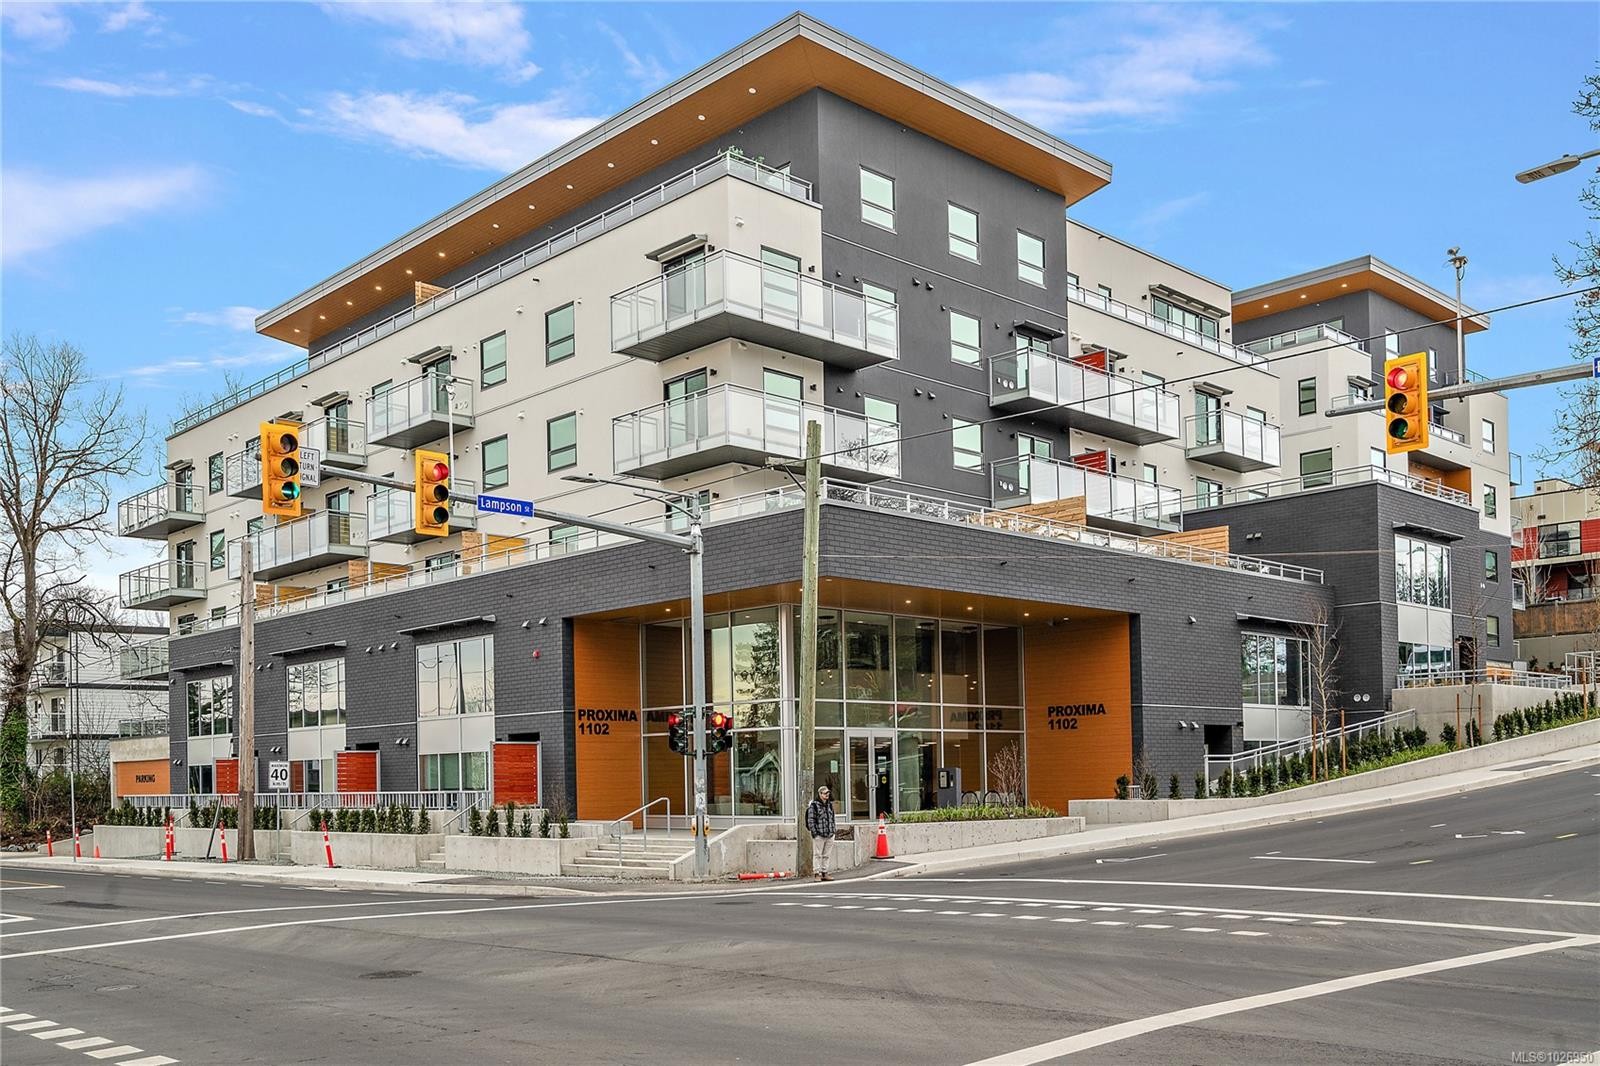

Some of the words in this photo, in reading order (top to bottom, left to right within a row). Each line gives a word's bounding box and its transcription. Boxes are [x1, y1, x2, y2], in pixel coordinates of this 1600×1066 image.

[300, 451, 315, 460] LEFT
[299, 461, 315, 471] TURN
[300, 472, 317, 482] IGNAL
[480, 497, 522, 512] Lampson
[578, 709, 637, 721] PROXIMA
[1048, 704, 1106, 717] PROXIMA
[578, 723, 609, 735] 1102
[1048, 718, 1078, 730] 1102
[135, 774, 156, 784] PARKING
[270, 769, 288, 780] 40
